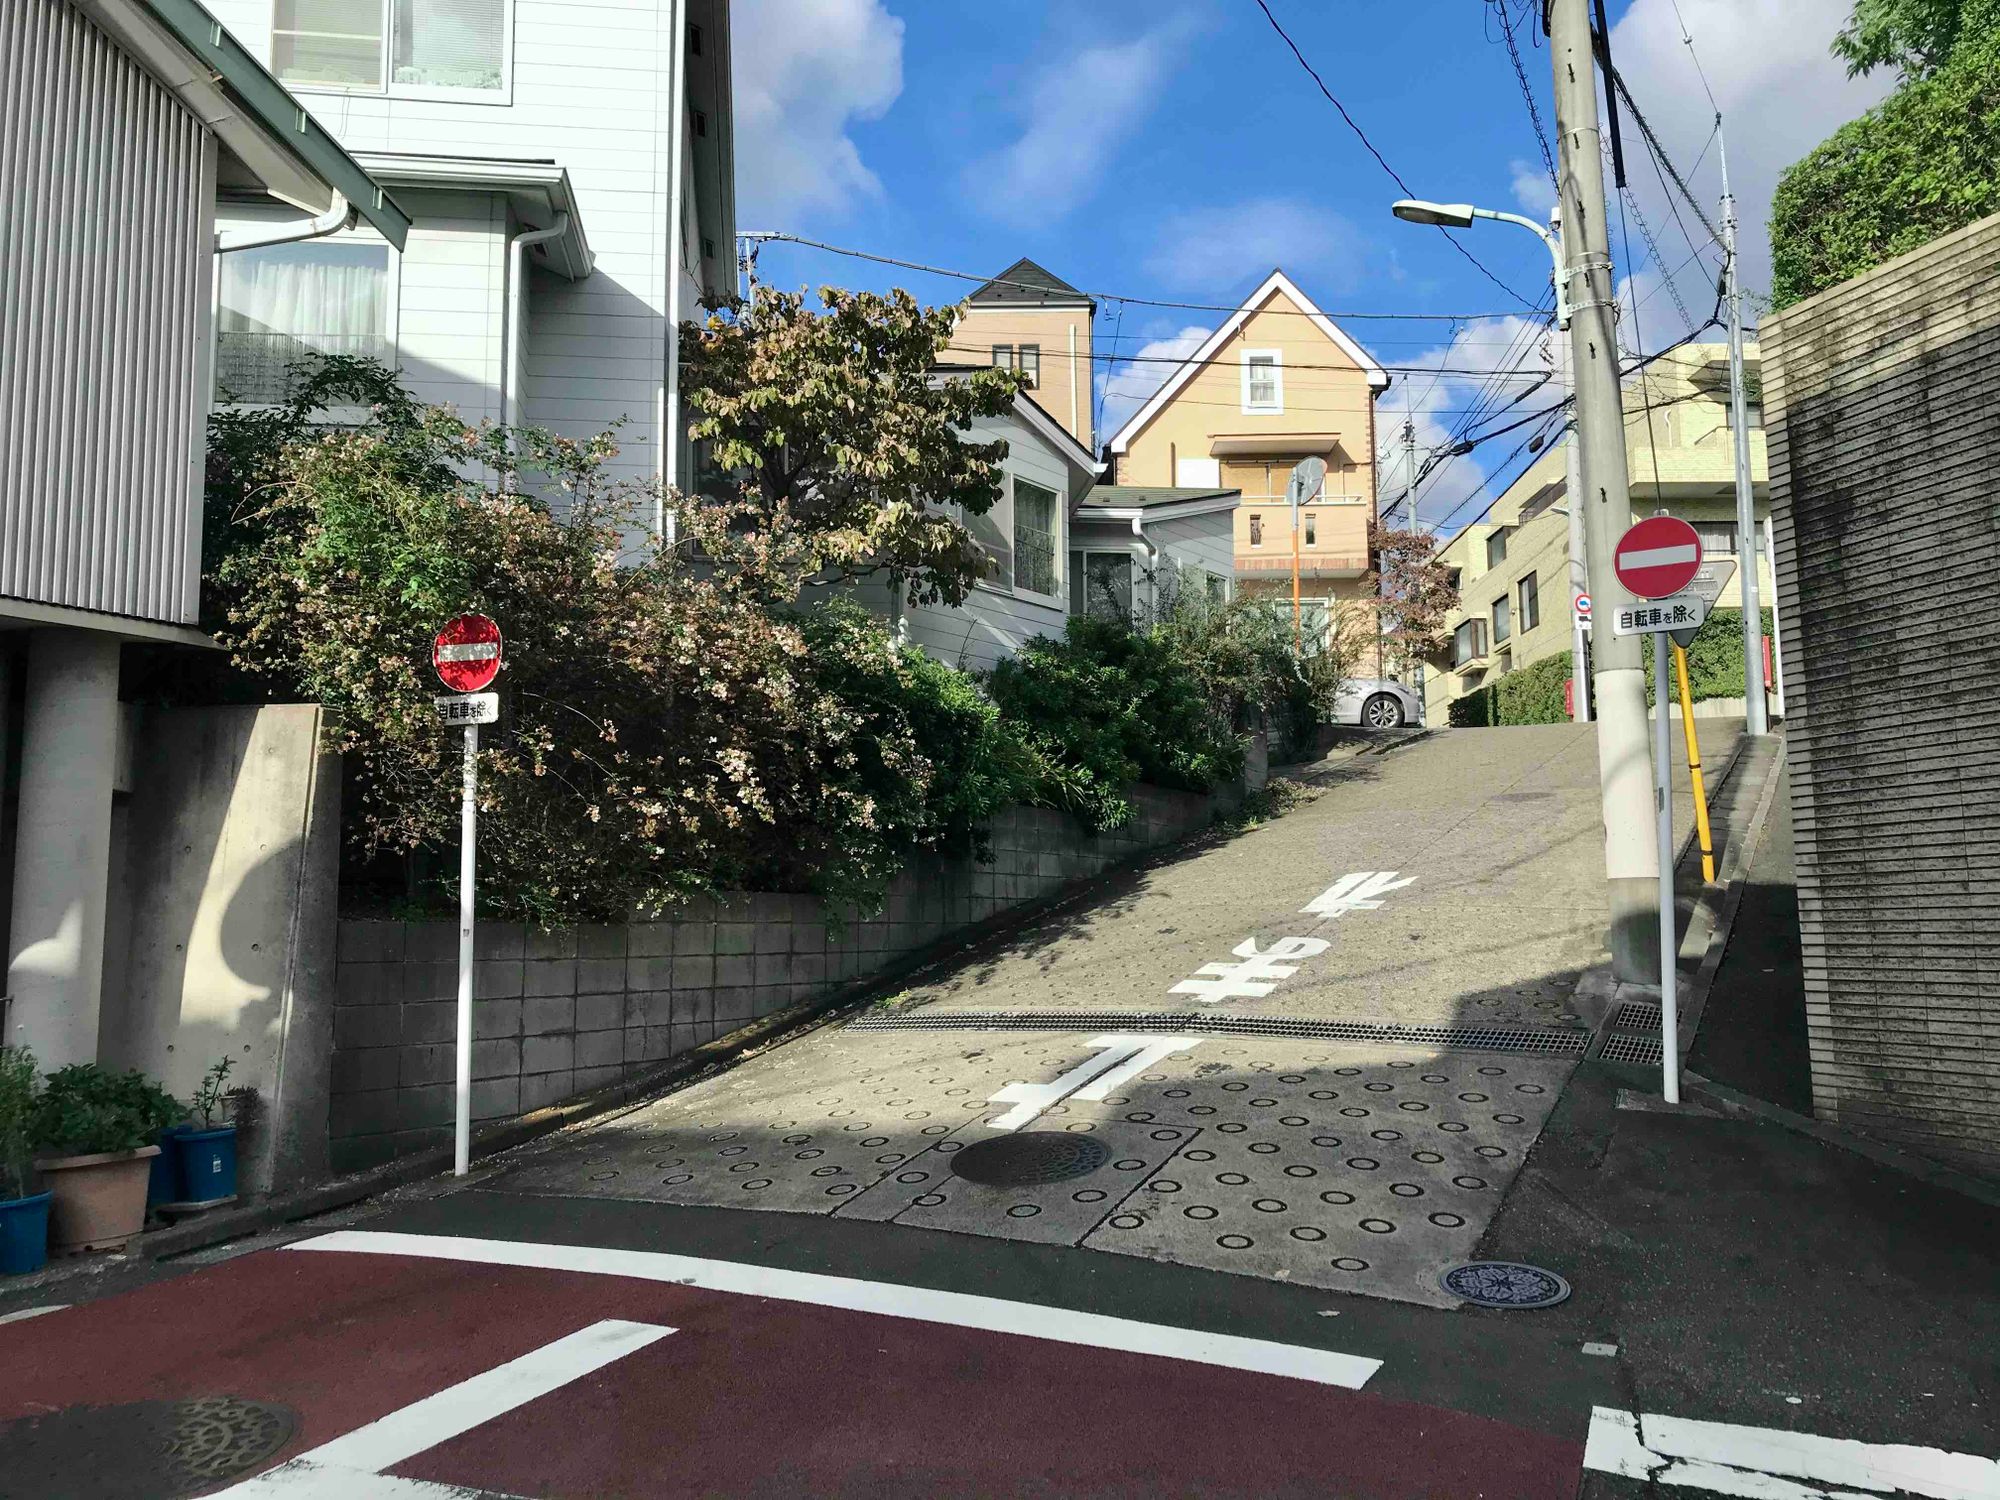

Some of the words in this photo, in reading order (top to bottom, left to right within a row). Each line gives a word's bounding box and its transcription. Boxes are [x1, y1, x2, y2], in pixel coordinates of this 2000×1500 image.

[1621, 605, 1695, 629] 自転車を除く
